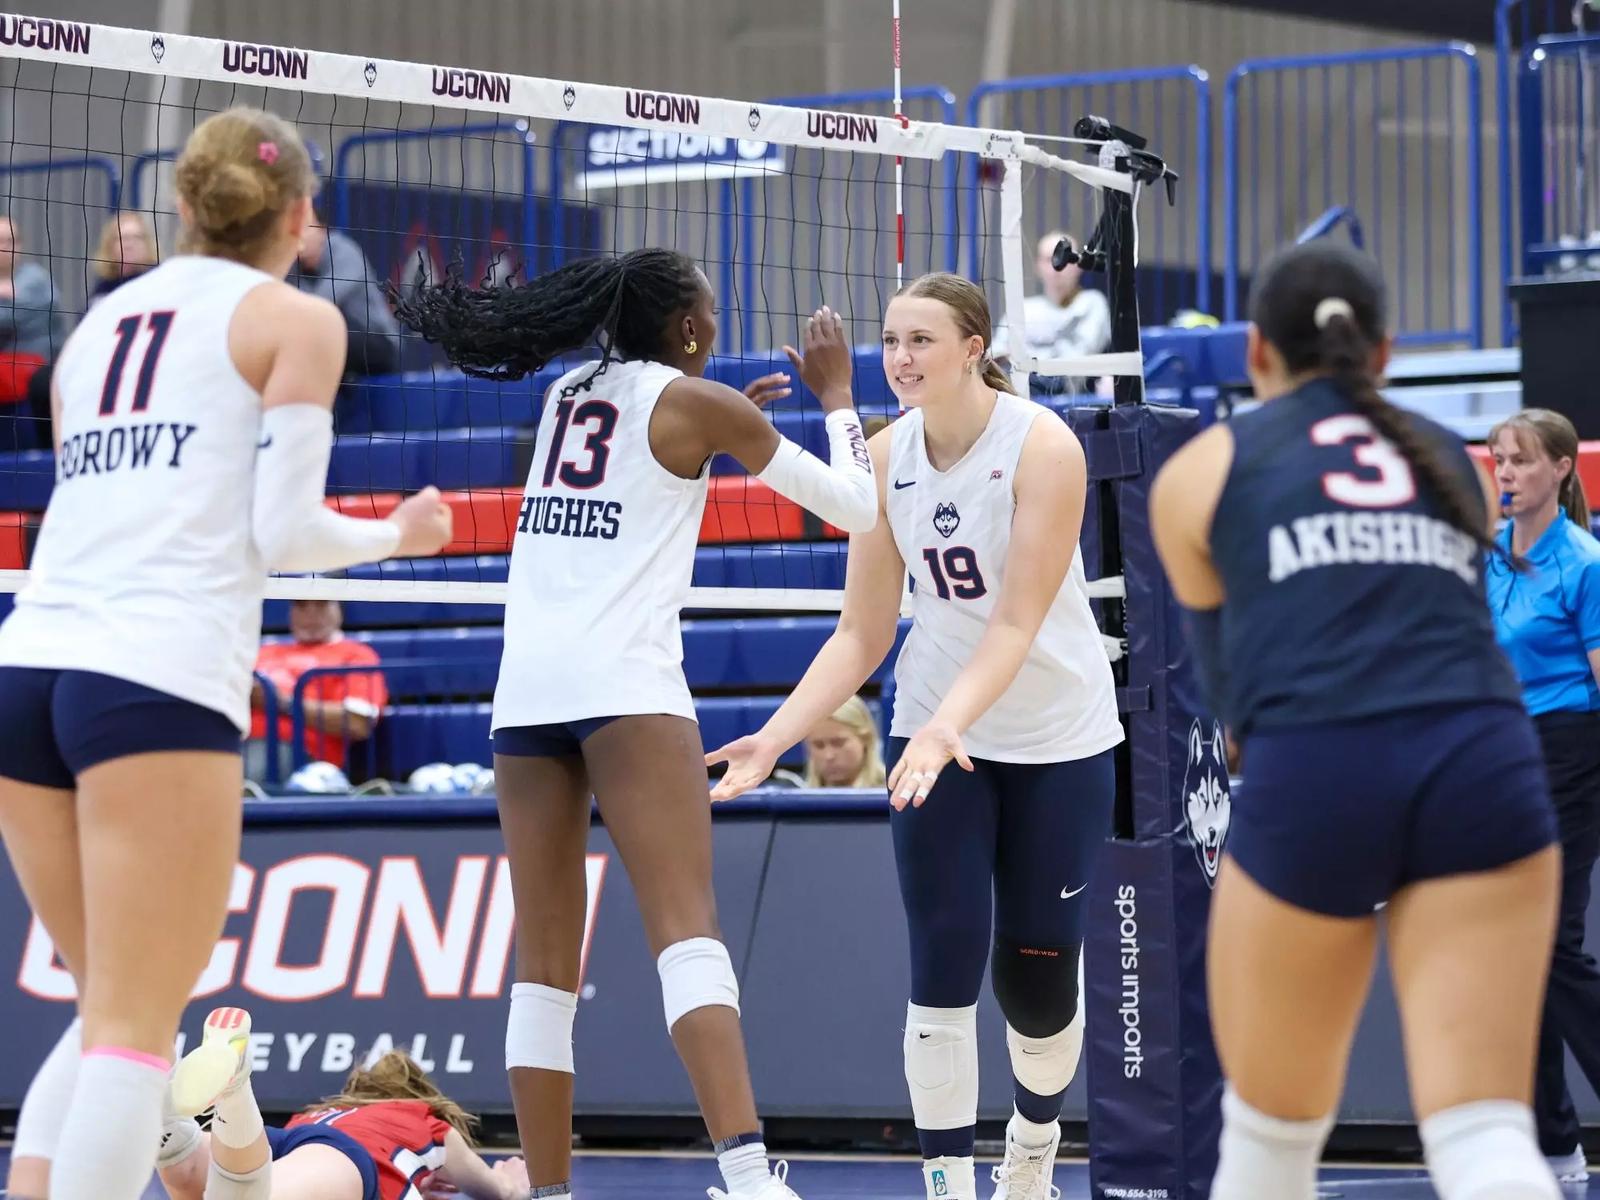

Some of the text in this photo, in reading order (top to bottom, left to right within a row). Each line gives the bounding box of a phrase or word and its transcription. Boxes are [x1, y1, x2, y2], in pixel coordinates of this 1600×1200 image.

[0, 15, 91, 54] UCONN
[222, 42, 308, 80] UCONN
[432, 67, 511, 104] UCONN
[625, 90, 700, 125] UCONN
[807, 111, 877, 143] UCONN
[98, 310, 178, 417] 11
[542, 399, 620, 490] 13
[844, 423, 871, 474] UCONN
[1310, 414, 1416, 508] 3
[518, 496, 622, 539] HUGHES
[922, 546, 987, 601] 19
[17, 853, 608, 1000] CON
[1114, 885, 1140, 970] sports
